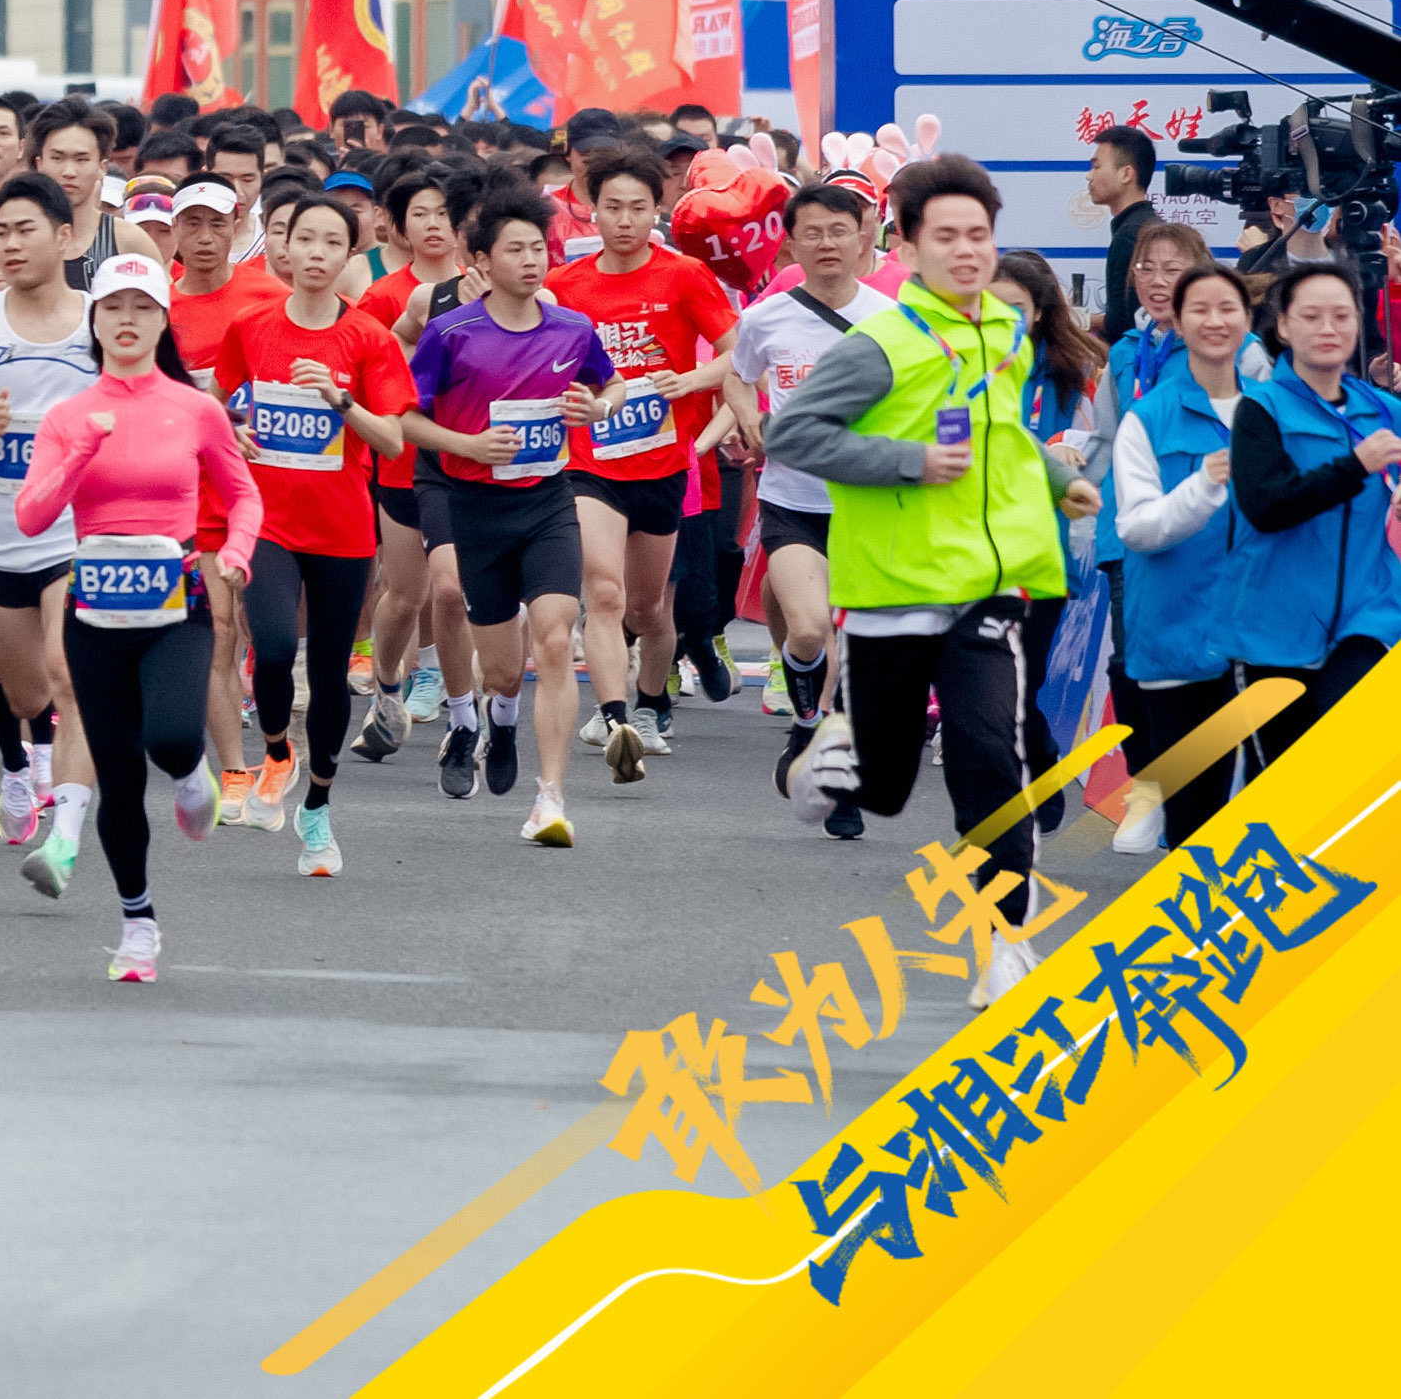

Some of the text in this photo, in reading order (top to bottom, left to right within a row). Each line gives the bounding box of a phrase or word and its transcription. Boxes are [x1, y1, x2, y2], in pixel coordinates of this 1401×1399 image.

[704, 210, 784, 262] 1:20
[256, 407, 332, 440] B2089
[514, 422, 563, 451] 1596
[79, 564, 170, 594] B2234
